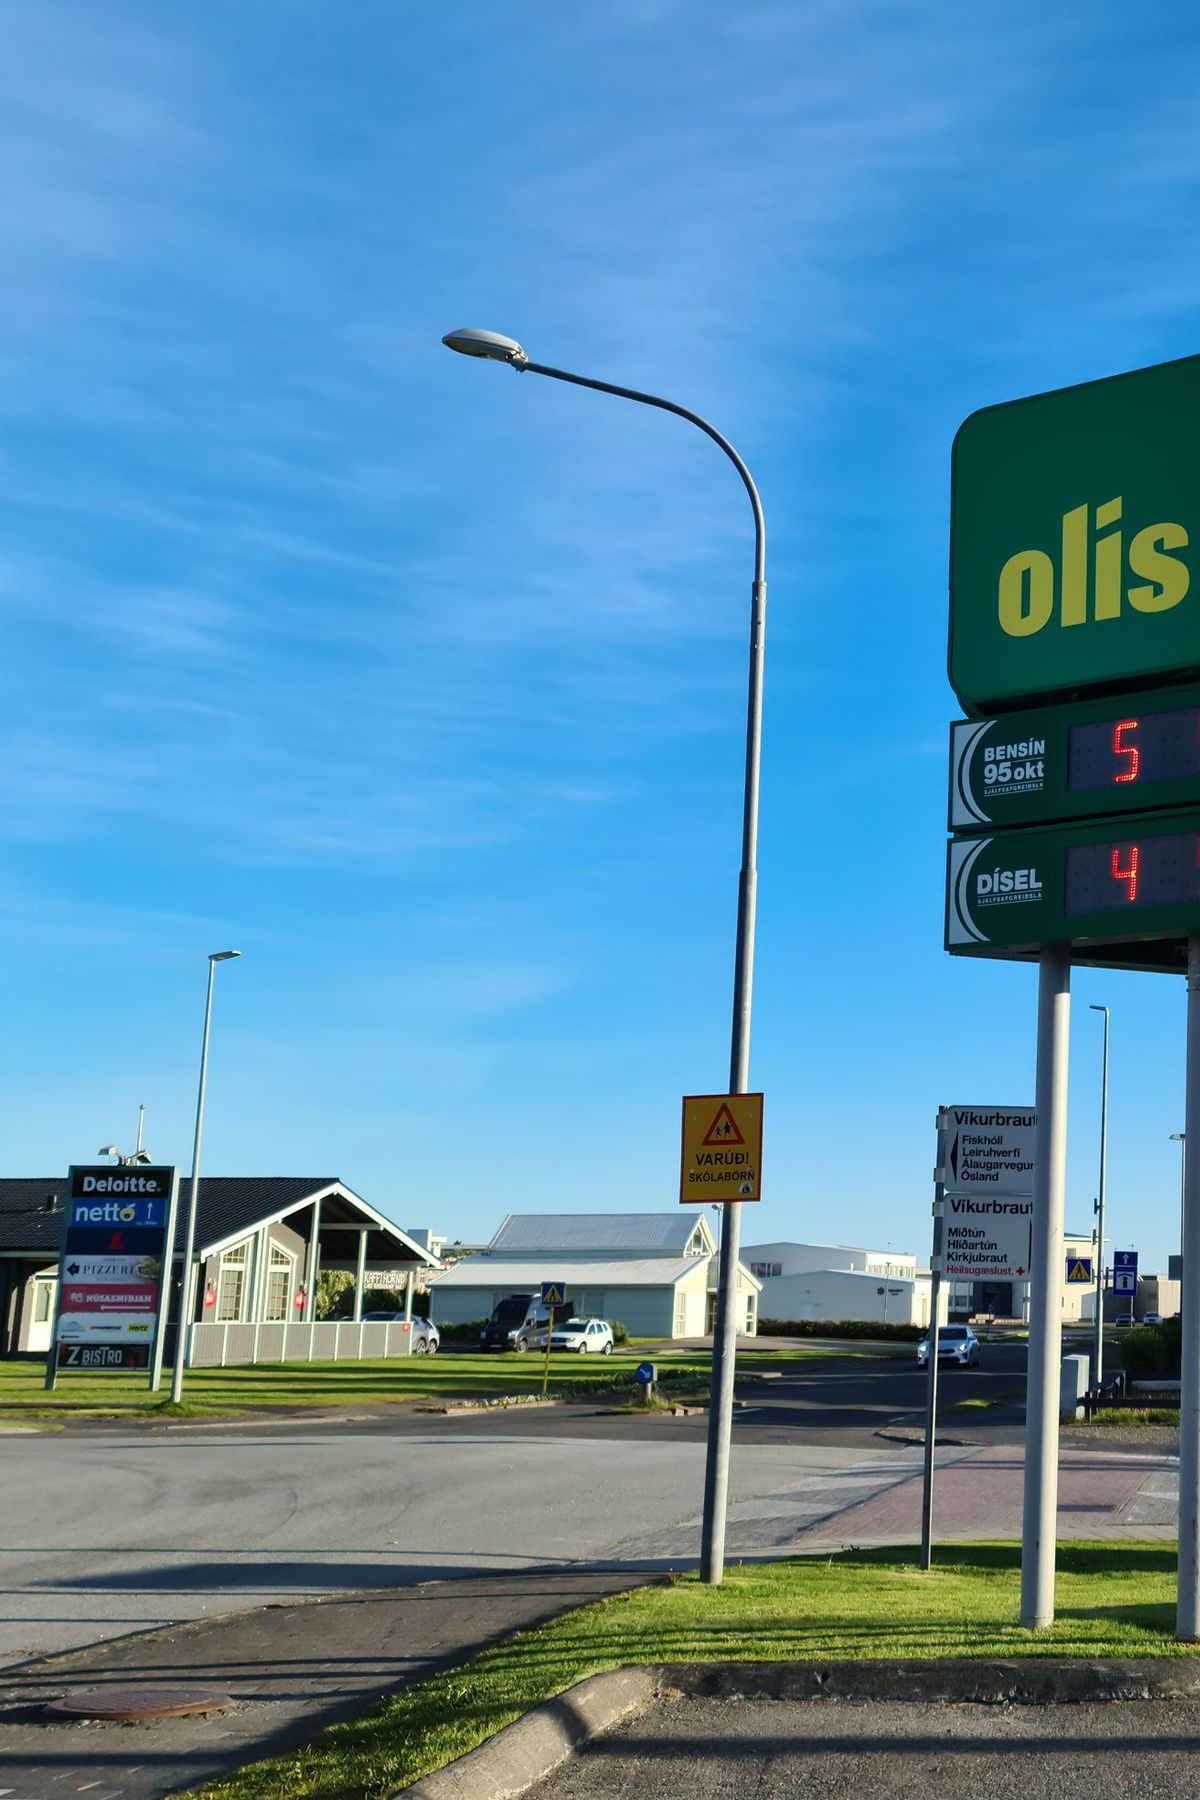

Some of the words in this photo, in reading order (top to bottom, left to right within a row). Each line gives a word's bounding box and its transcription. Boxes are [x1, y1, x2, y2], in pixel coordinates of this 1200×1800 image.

[984, 738, 1045, 761] BENSÍN
[1112, 721, 1139, 783] 5
[984, 762, 1012, 784] 95
[1013, 761, 1045, 780] okt
[977, 867, 1043, 895] DÍSEL
[1112, 847, 1138, 902] 4
[962, 1135, 1003, 1145] Fiskhóll
[962, 1147, 1020, 1157] Leiruhverfi
[961, 1157, 1034, 1172] Álaugarvegur
[961, 1169, 999, 1182] Ósland
[948, 1227, 986, 1238] Miðtún
[948, 1240, 997, 1250] Hlíðartún
[947, 1252, 1008, 1264] Kirkjubraut
